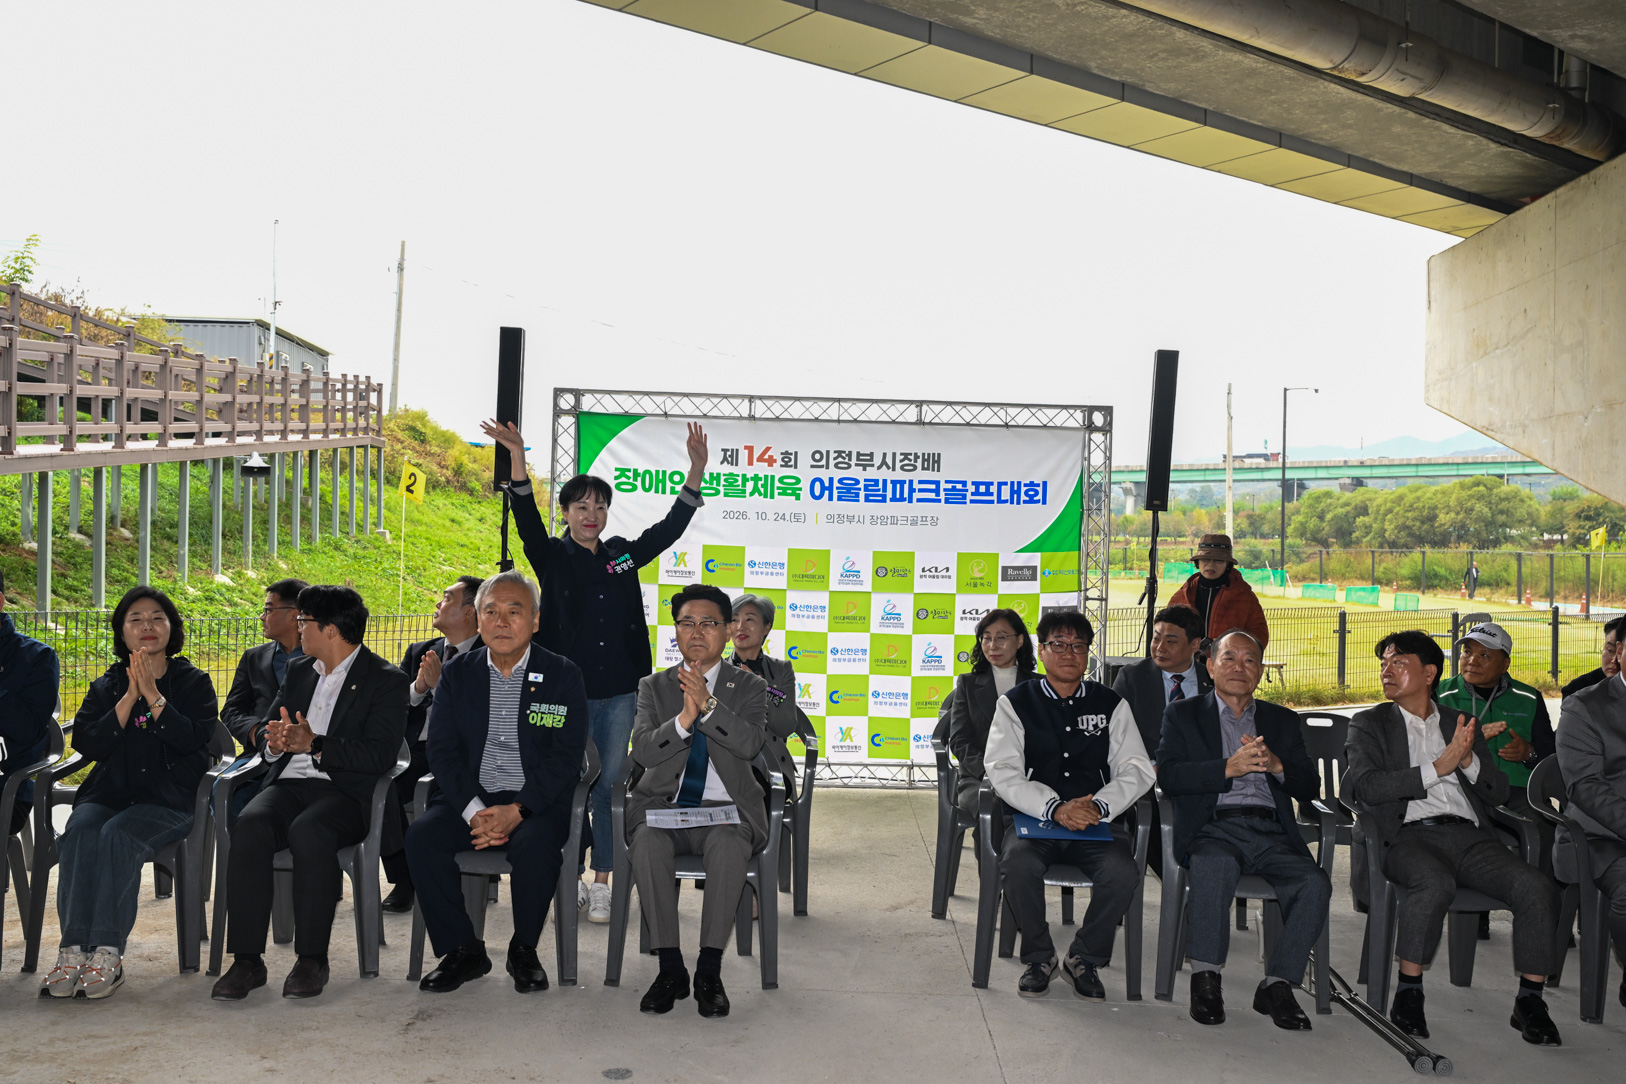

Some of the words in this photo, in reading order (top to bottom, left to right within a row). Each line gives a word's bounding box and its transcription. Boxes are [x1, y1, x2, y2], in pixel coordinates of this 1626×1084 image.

[810, 449, 942, 473] 의정부시장배
[405, 472, 417, 495] 2
[700, 471, 803, 502] 생활체육
[808, 476, 1049, 506] 어울림파크골프대회
[722, 510, 751, 521] 2026.
[755, 511, 770, 521] 10.
[773, 512, 806, 524] 24.(토)
[825, 513, 865, 525] 의정부시
[869, 514, 939, 526] 장암파크골프장
[757, 561, 785, 570] 신한은행
[798, 603, 826, 613] 신한은행
[840, 648, 868, 656] 신한은행
[881, 690, 908, 700] 신한은행
[529, 702, 568, 716] 국회의원
[528, 712, 566, 728] 이재강
[1077, 714, 1107, 731] UPG
